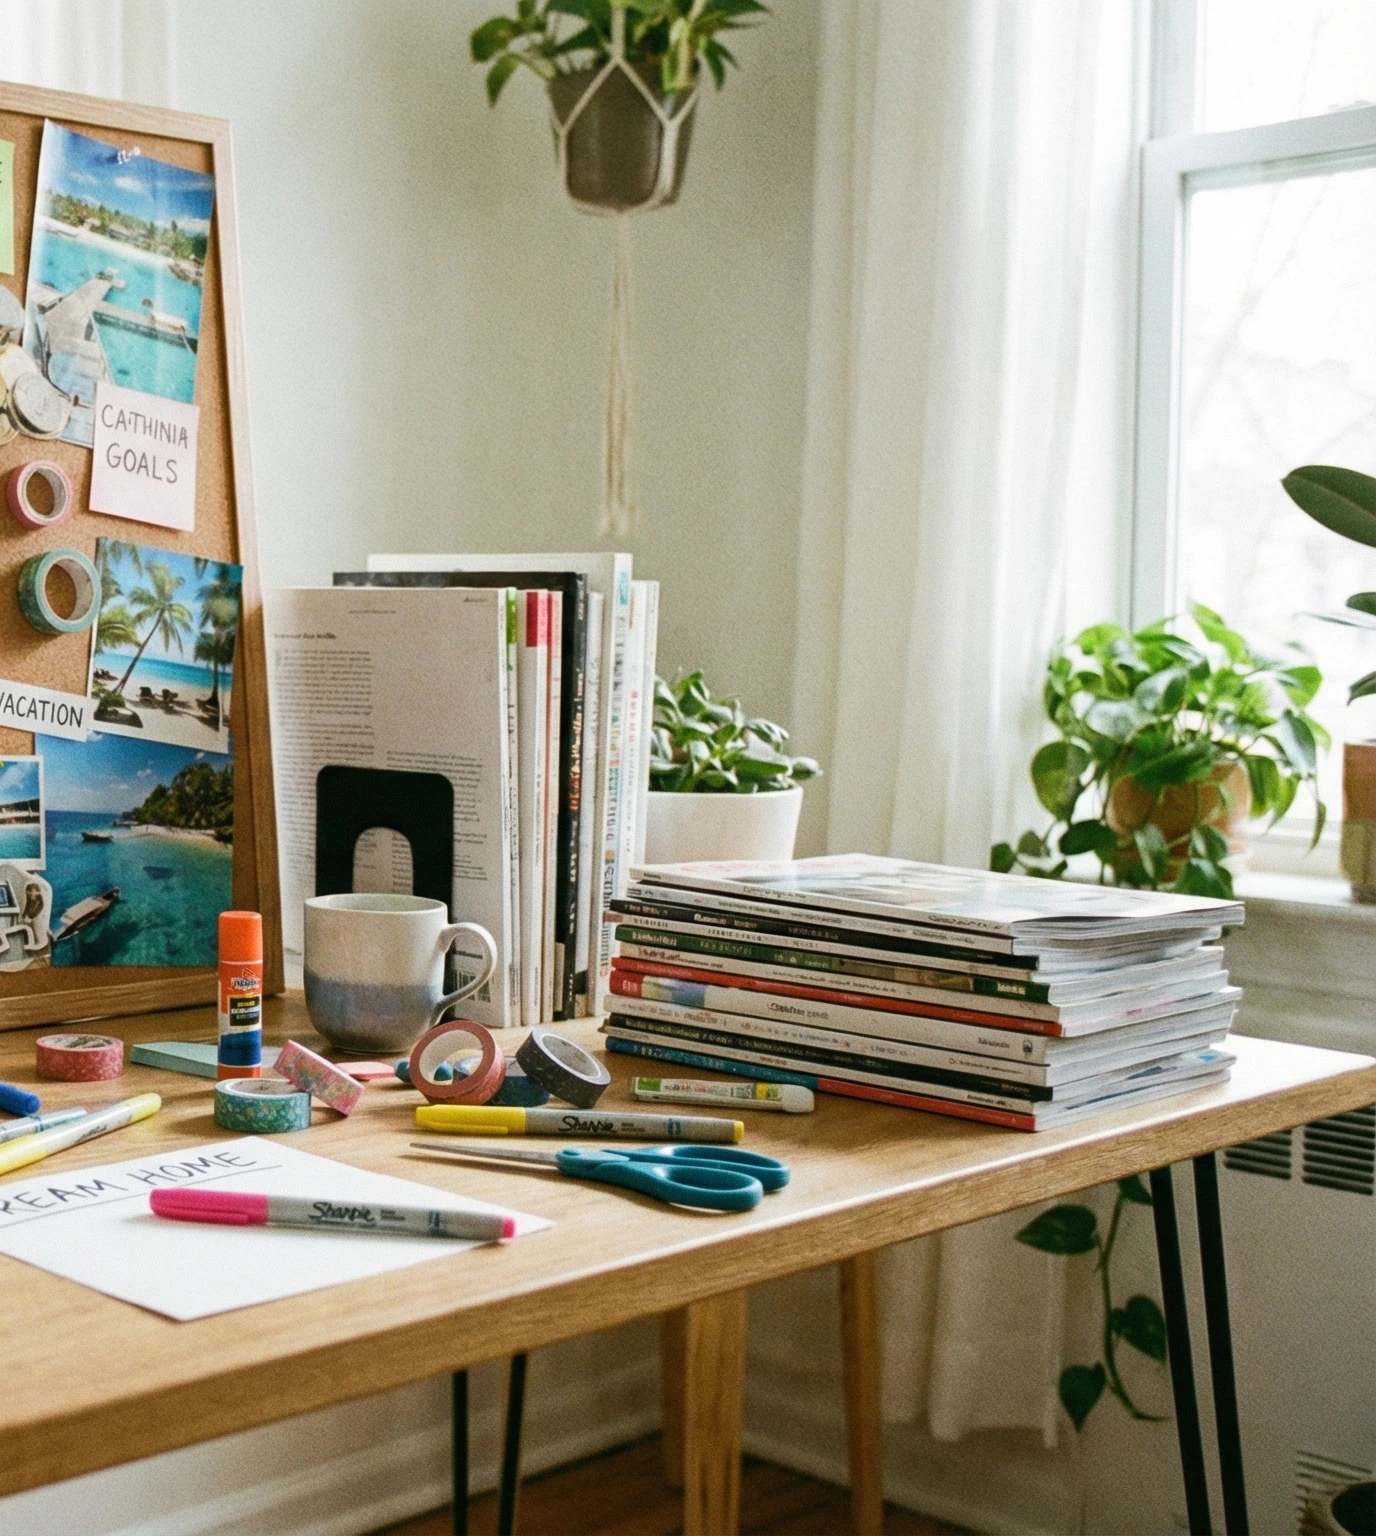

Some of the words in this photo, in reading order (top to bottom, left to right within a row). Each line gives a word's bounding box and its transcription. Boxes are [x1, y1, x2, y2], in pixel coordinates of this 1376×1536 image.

[106, 442, 178, 484] GOALS
[126, 1151, 258, 1186] HOME
[308, 1201, 375, 1223] Sharpie
